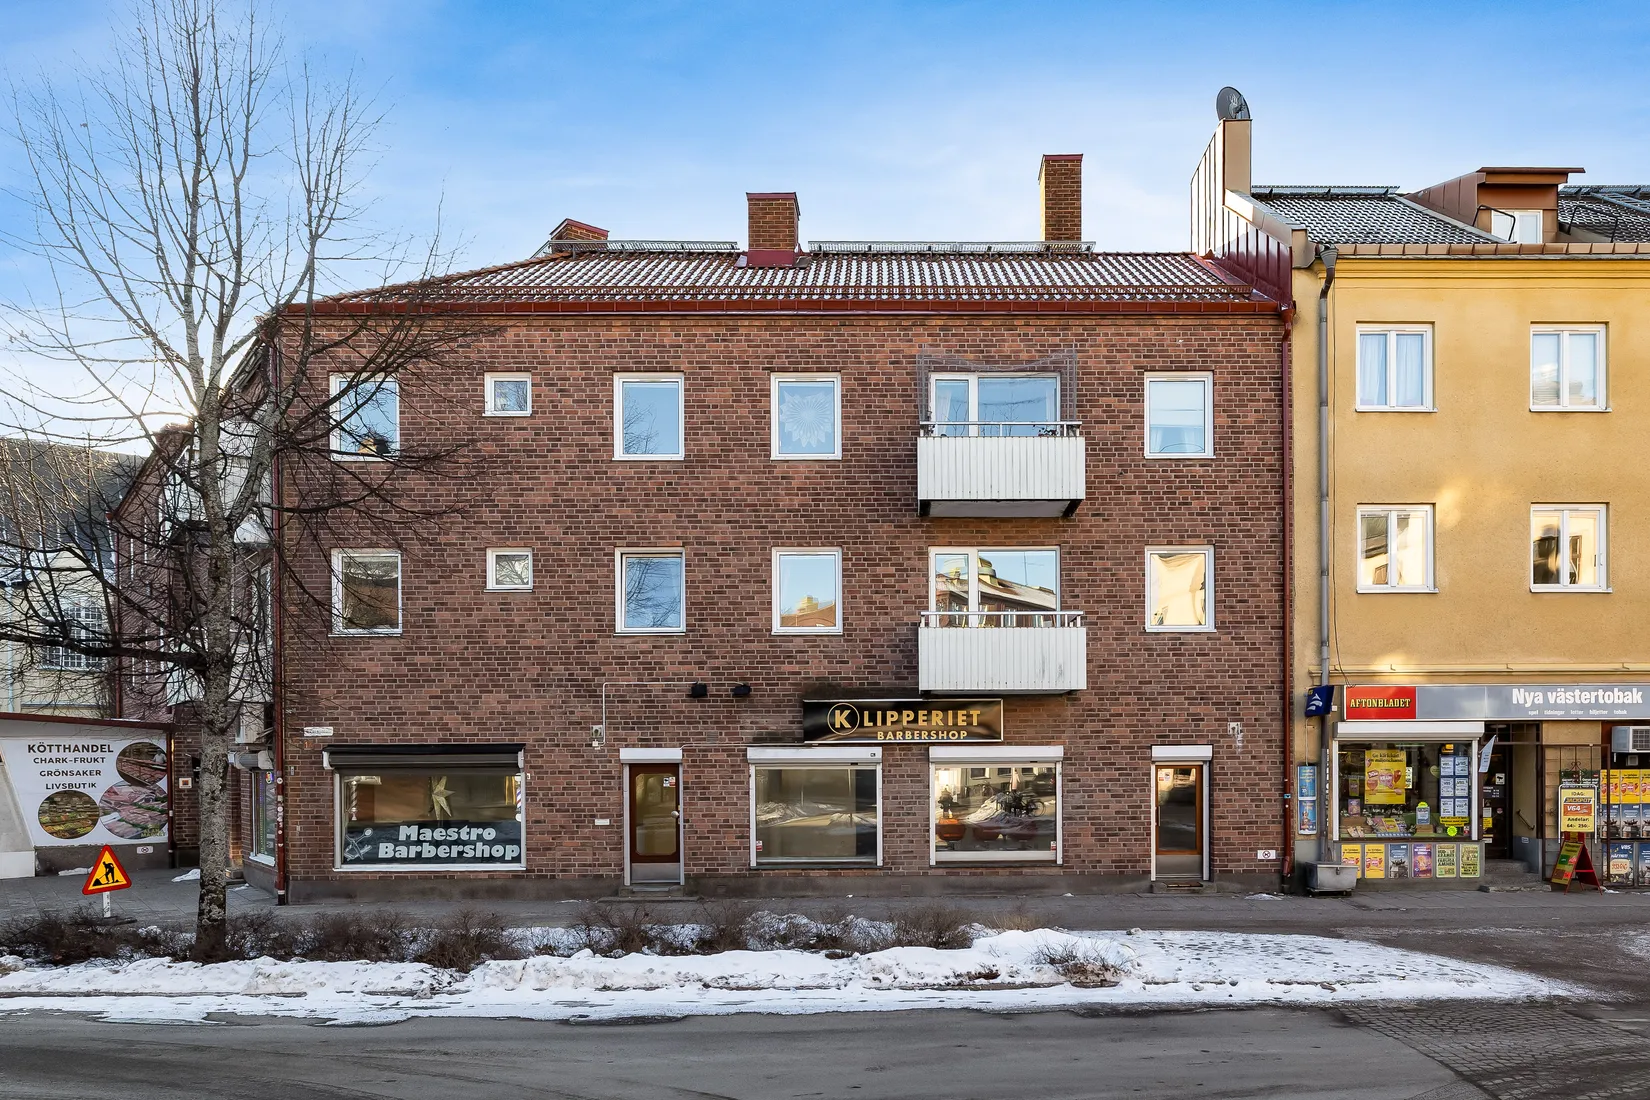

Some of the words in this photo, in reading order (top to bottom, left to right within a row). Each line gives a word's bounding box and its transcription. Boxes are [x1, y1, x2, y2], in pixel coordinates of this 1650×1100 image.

[1350, 698, 1412, 708] AFTONBLADET
[1512, 688, 1543, 707] Nya
[1547, 688, 1643, 704] västertobak
[877, 731, 968, 740] BARBERSHOP
[27, 742, 114, 753] KÖTTHANDEL
[39, 769, 102, 777] GRÖNSAKER
[398, 825, 496, 841] Maestro
[378, 842, 520, 860] Barbershop
